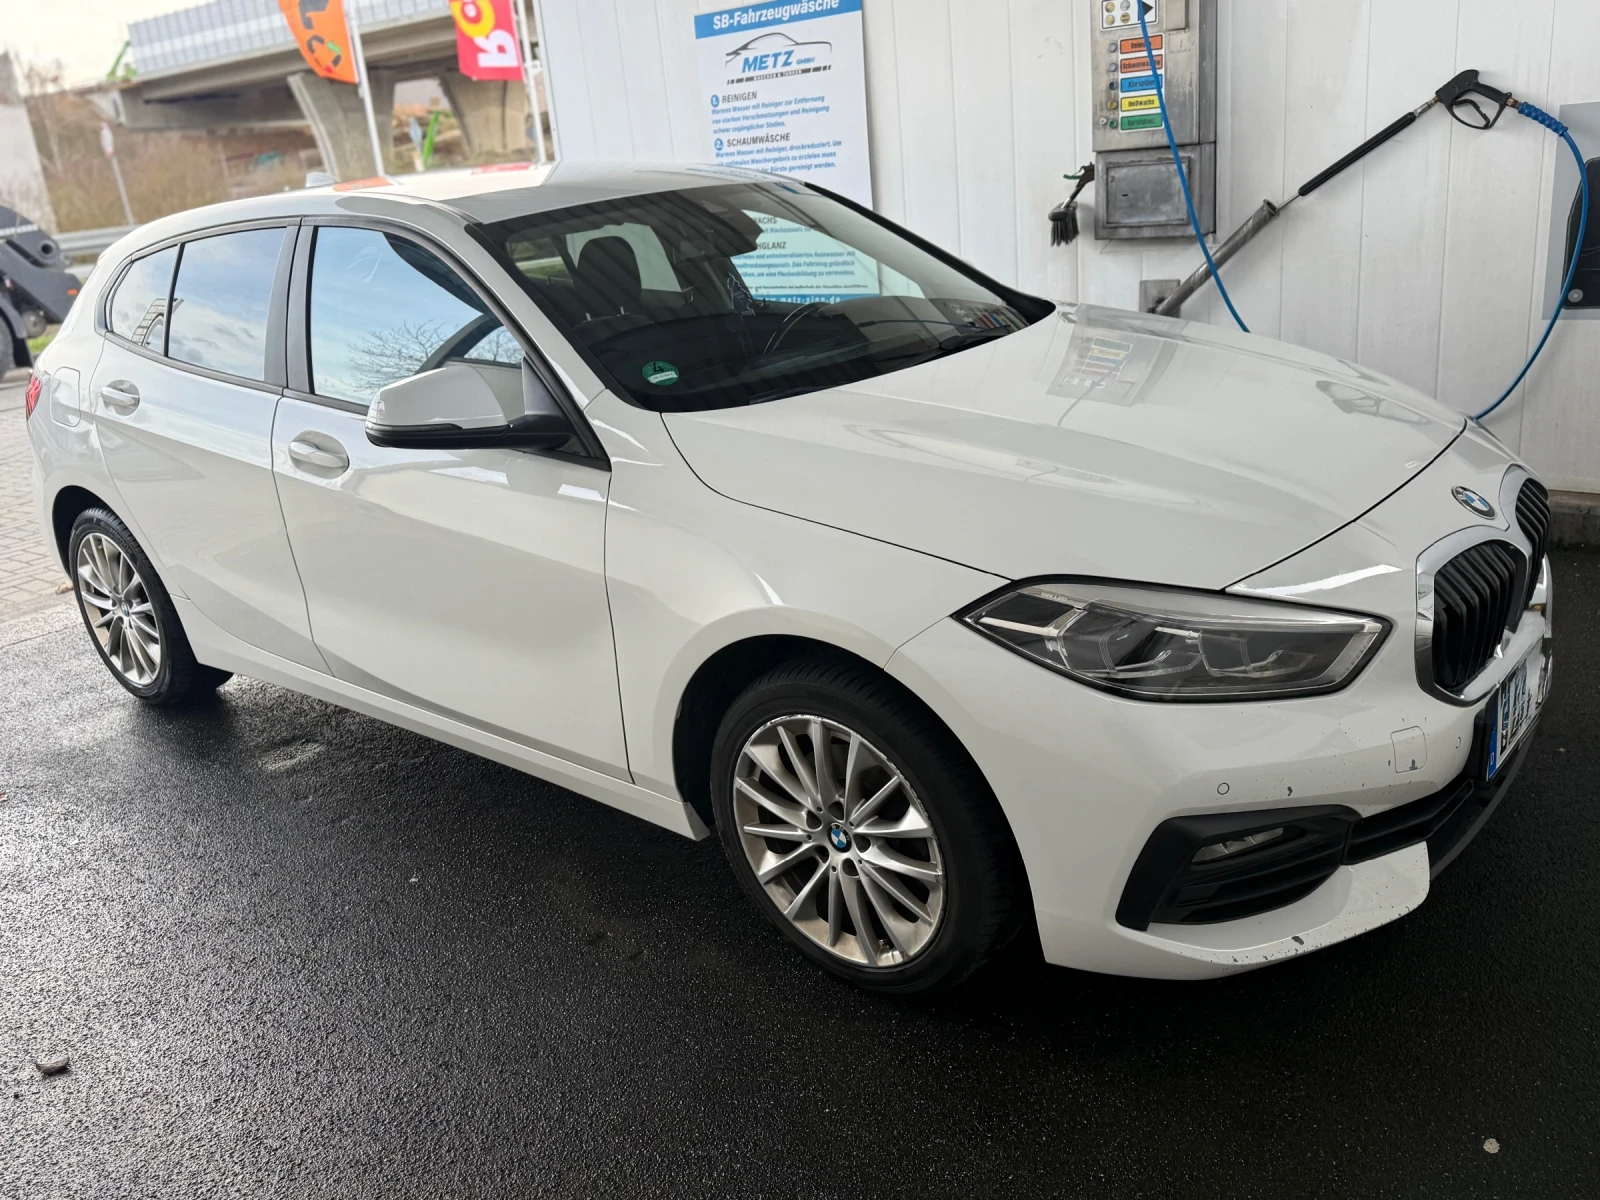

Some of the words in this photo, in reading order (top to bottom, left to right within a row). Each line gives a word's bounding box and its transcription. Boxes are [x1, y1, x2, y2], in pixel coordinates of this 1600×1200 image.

[713, 0, 840, 30] SB-Fahrzeugwäsche
[742, 49, 795, 73] METZ
[721, 91, 758, 104] REINIGEN
[801, 105, 830, 114] Reinigung
[726, 132, 791, 148] SCHAUMWÄSCHE
